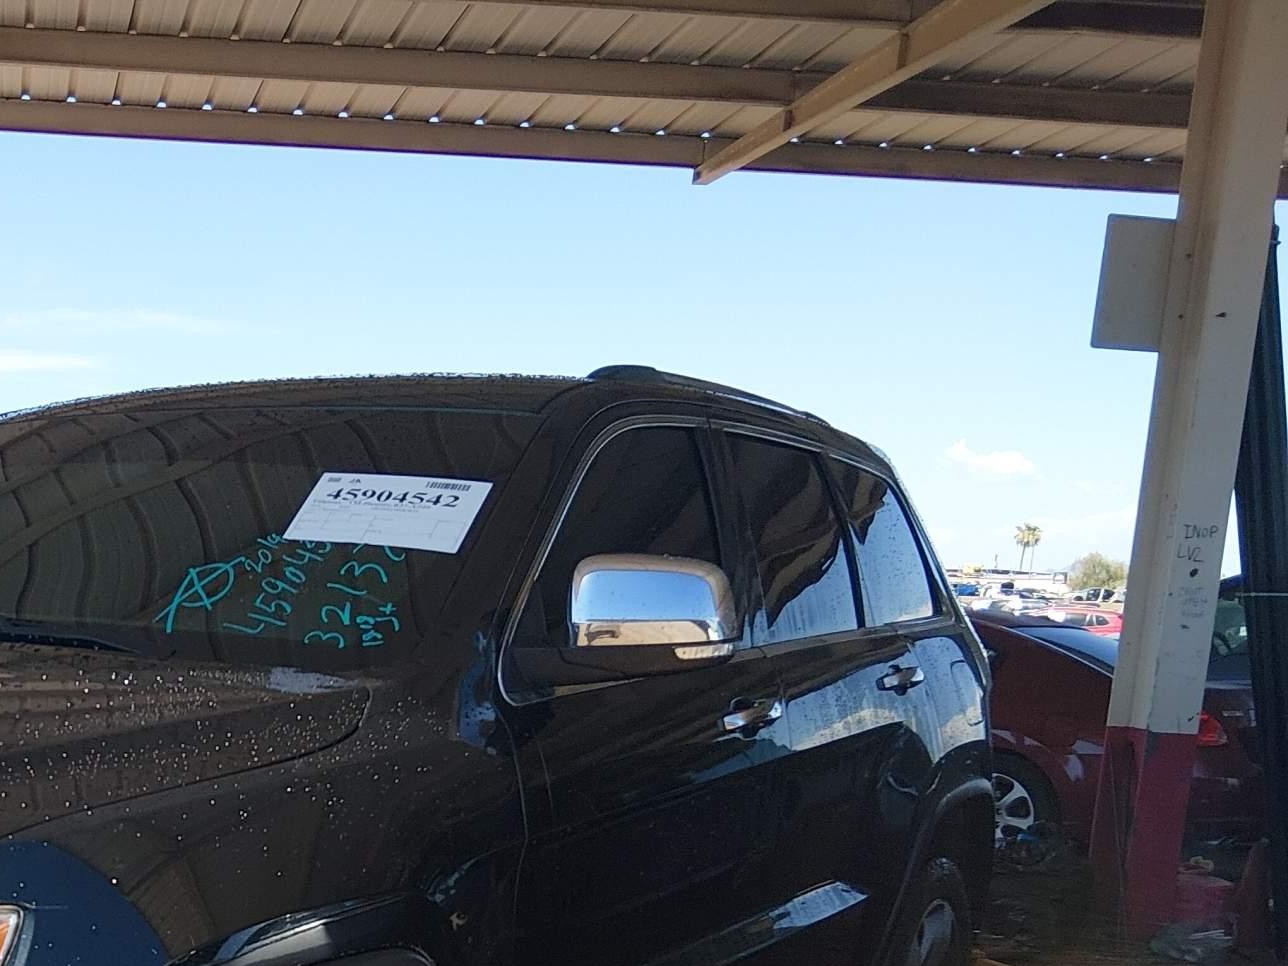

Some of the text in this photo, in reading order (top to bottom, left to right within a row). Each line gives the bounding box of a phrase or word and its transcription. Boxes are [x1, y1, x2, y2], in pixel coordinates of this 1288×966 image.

[326, 487, 461, 508] 45904542
[1183, 523, 1219, 540] INOP
[303, 543, 406, 649] 3213
